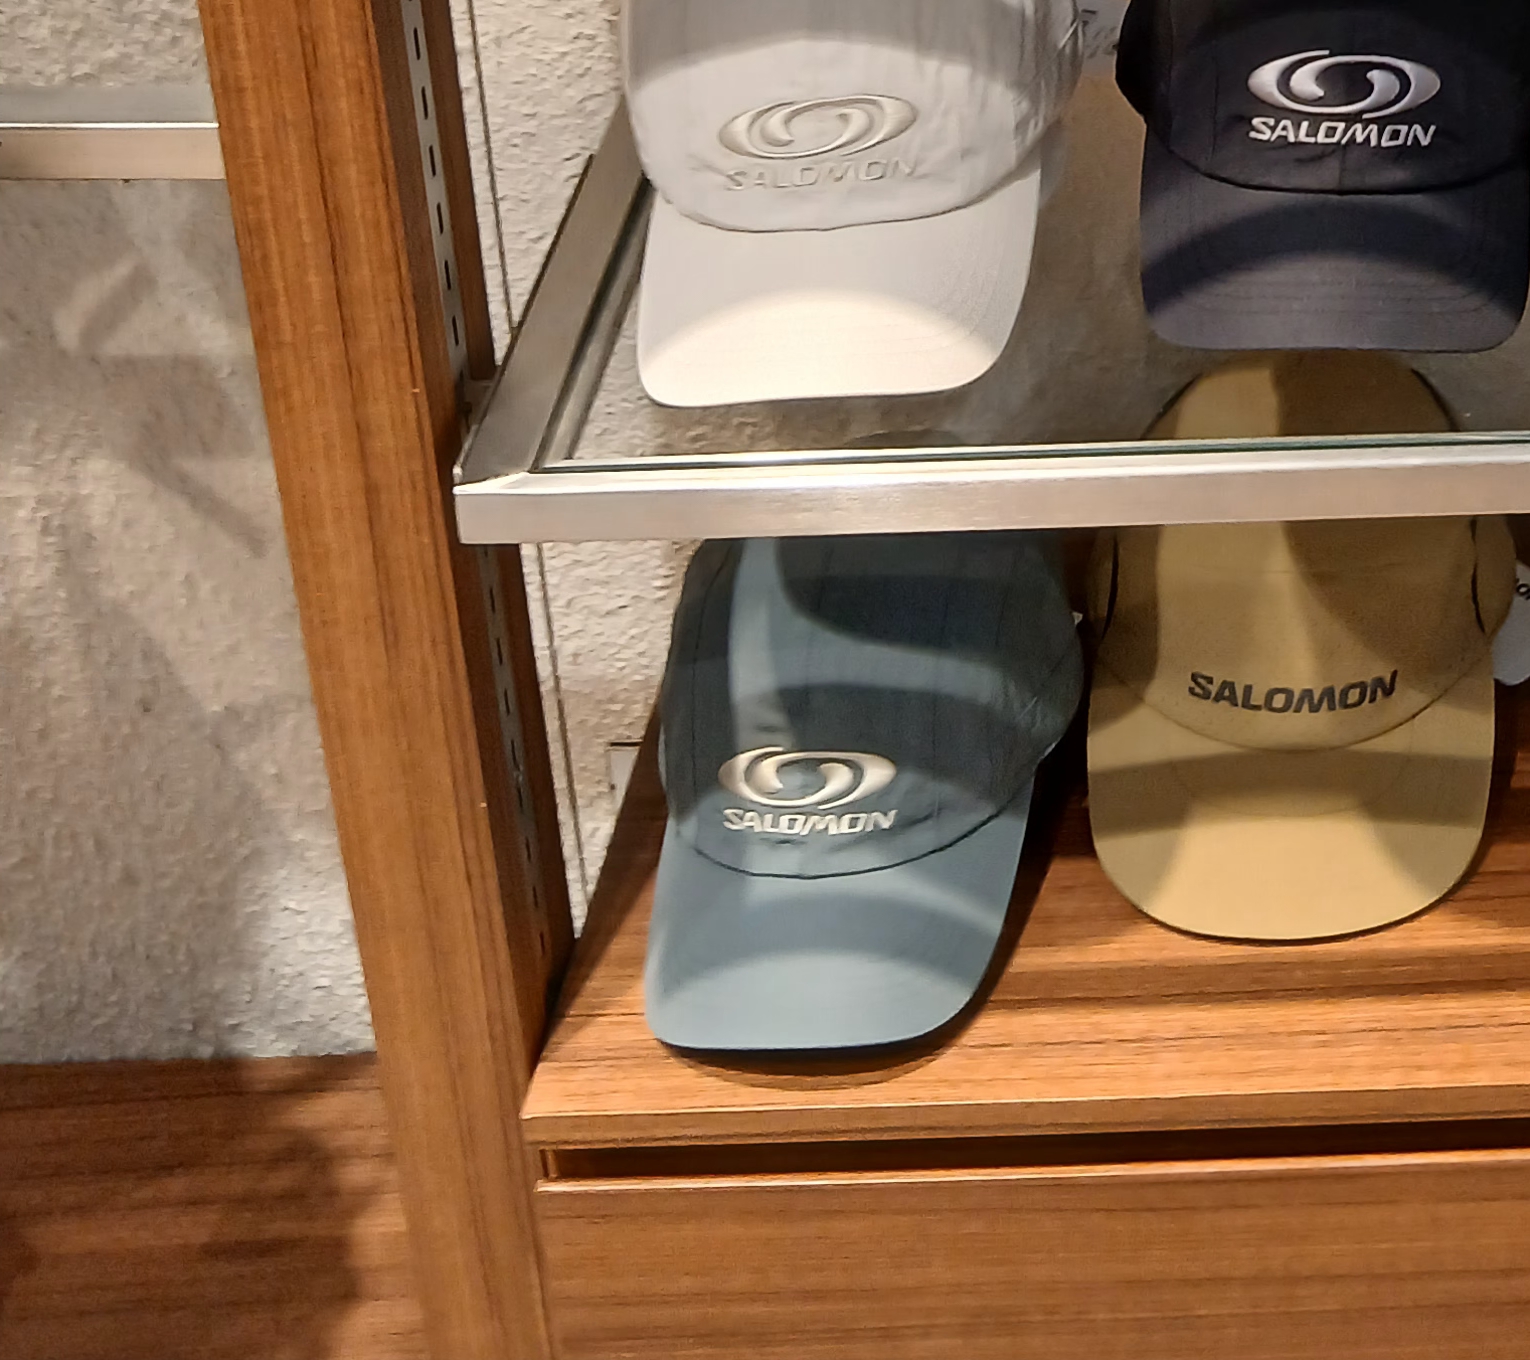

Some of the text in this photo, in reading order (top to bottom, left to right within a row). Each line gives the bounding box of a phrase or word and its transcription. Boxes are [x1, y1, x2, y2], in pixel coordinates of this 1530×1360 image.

[1249, 115, 1437, 148] SALOMON
[725, 156, 920, 192] SALOMON
[1188, 670, 1400, 714] SALOMON
[722, 809, 898, 835] SALOMON
